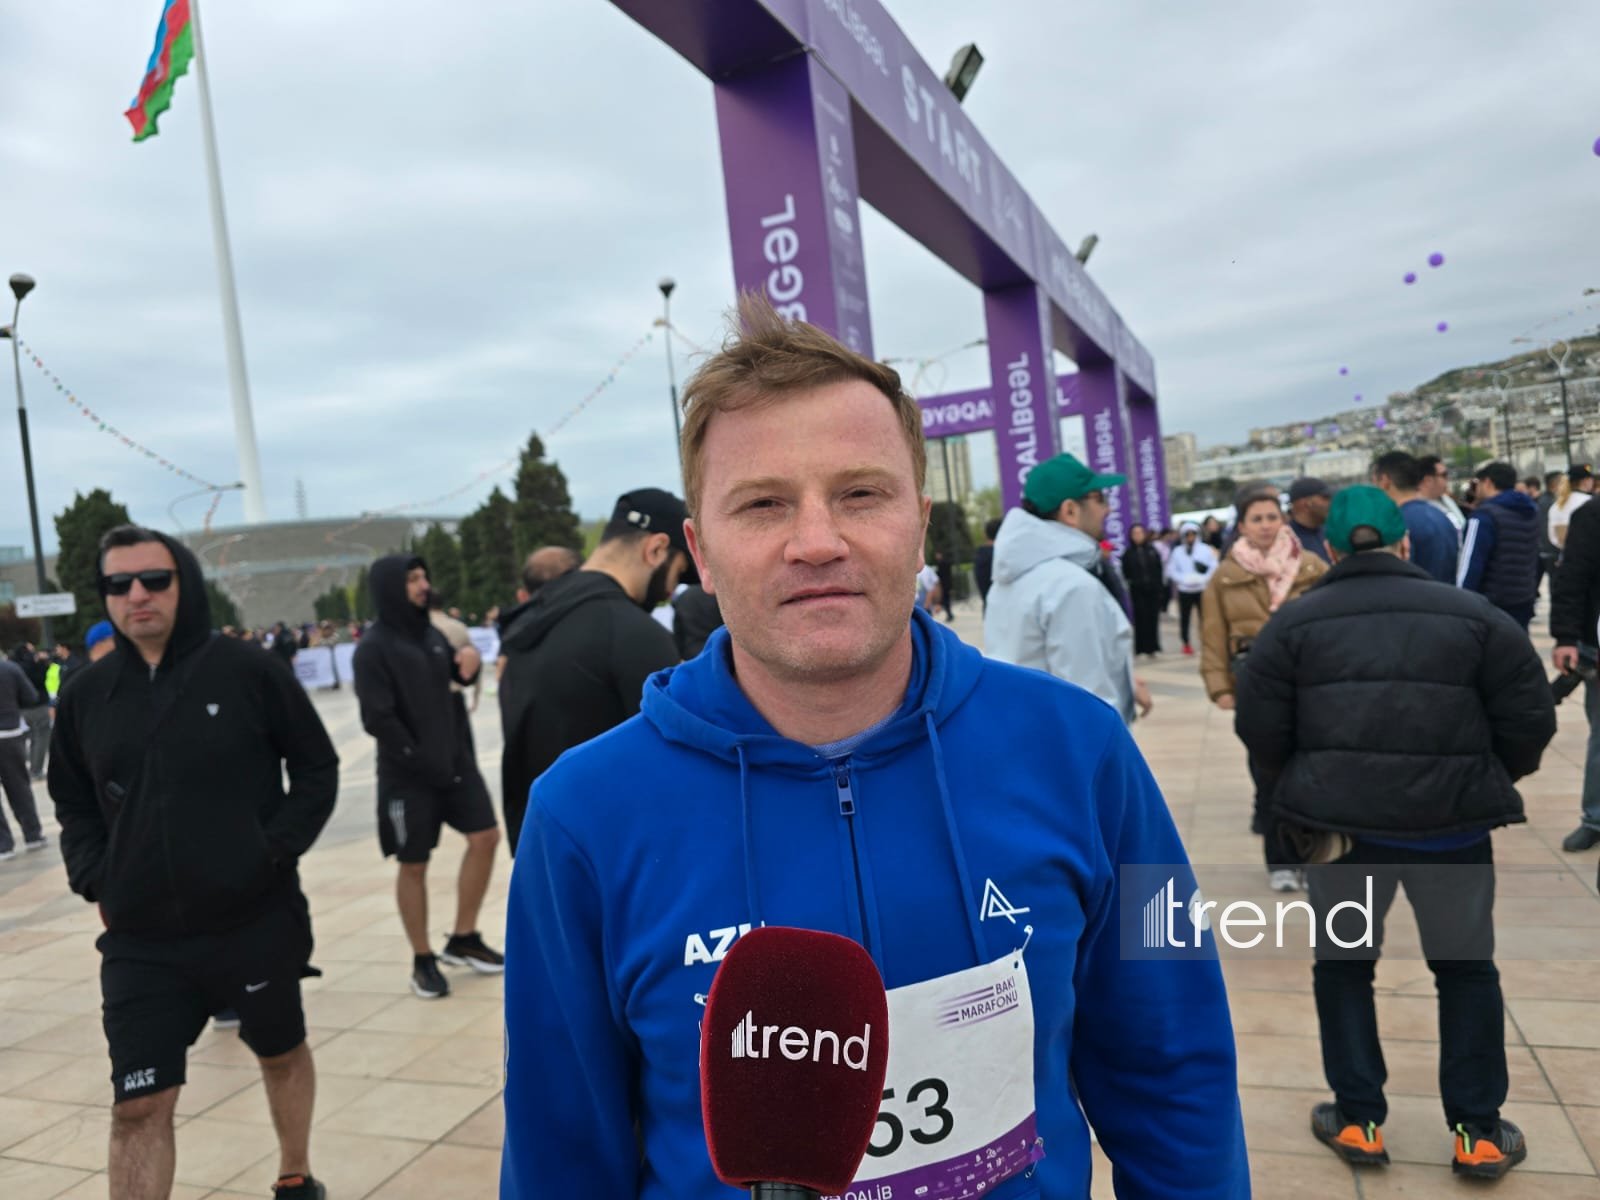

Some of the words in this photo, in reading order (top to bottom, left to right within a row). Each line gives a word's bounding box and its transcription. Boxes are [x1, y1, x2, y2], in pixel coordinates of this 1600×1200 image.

[902, 64, 983, 196] START
[684, 923, 752, 966] AZ
[961, 990, 1018, 1021] MARAFONU
[995, 975, 1016, 995] BAKI
[746, 1010, 871, 1072] trend
